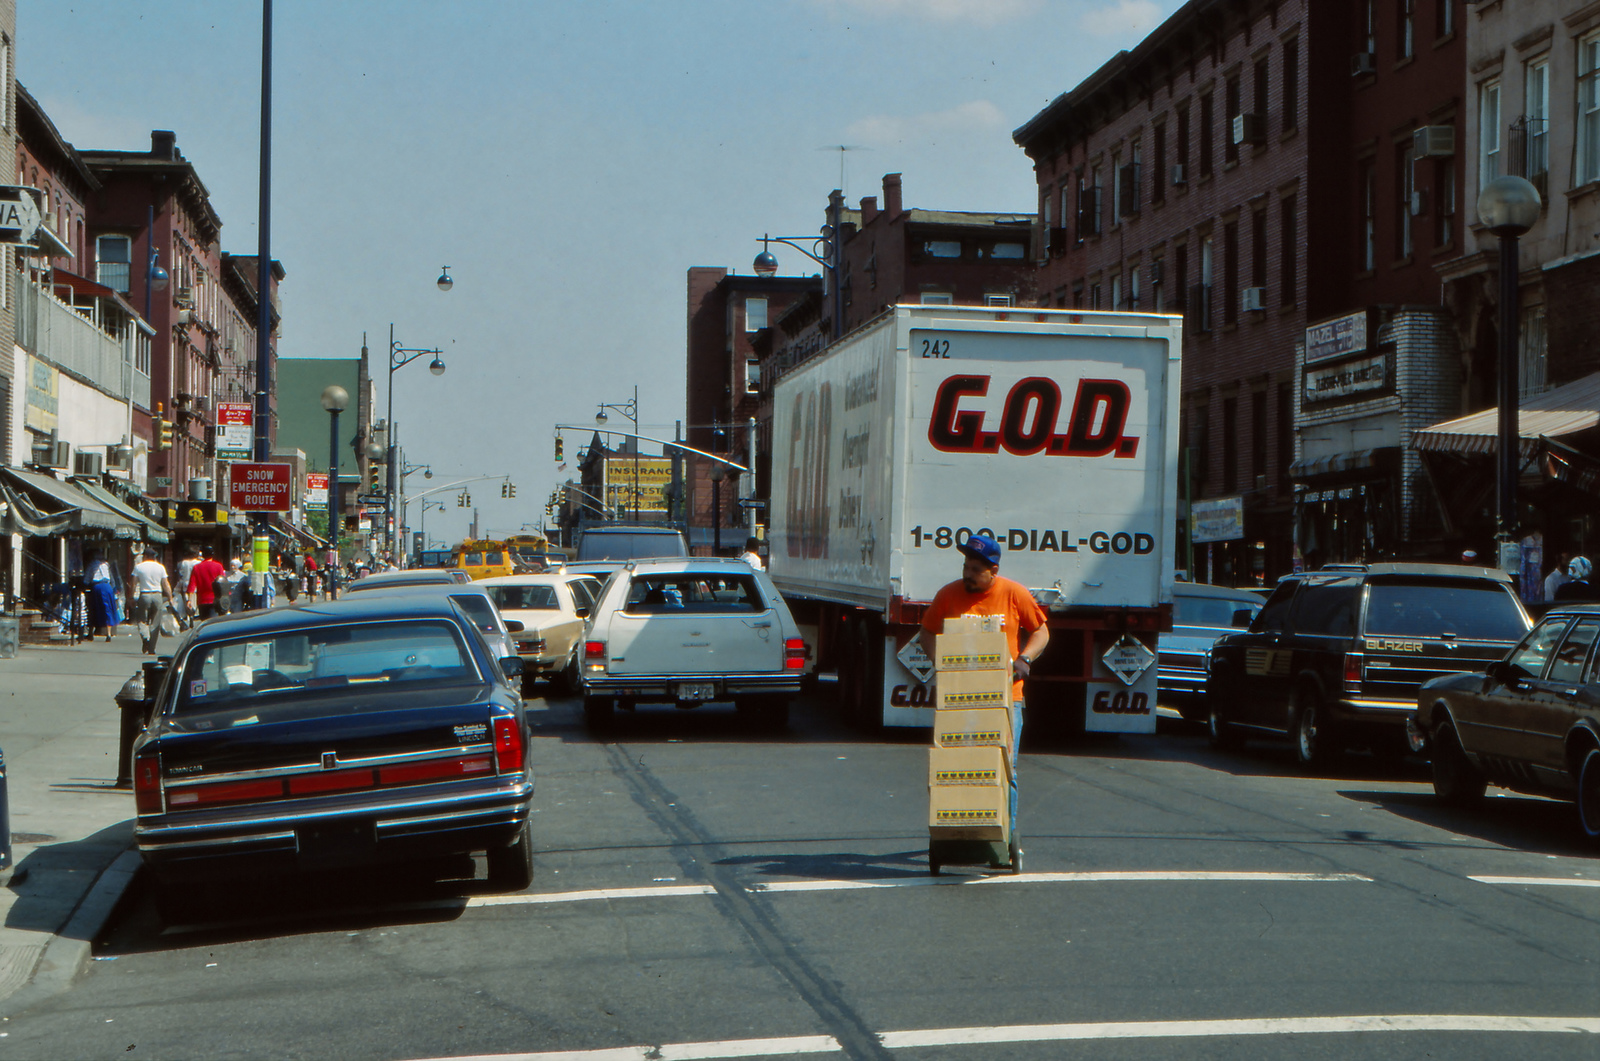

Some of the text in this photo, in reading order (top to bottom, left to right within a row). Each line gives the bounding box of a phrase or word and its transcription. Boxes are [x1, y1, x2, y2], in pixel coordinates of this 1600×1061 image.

[922, 340, 950, 358] 242
[928, 374, 1140, 458] G.O.D.
[247, 470, 274, 480] SNOW
[609, 467, 673, 475] INSURANC
[232, 482, 288, 493] EMERGENCY
[245, 495, 275, 505] ROUTE
[1366, 639, 1424, 653] BLAZER
[1092, 691, 1150, 715] G.O.D.
[458, 734, 486, 743] LINCOLN
